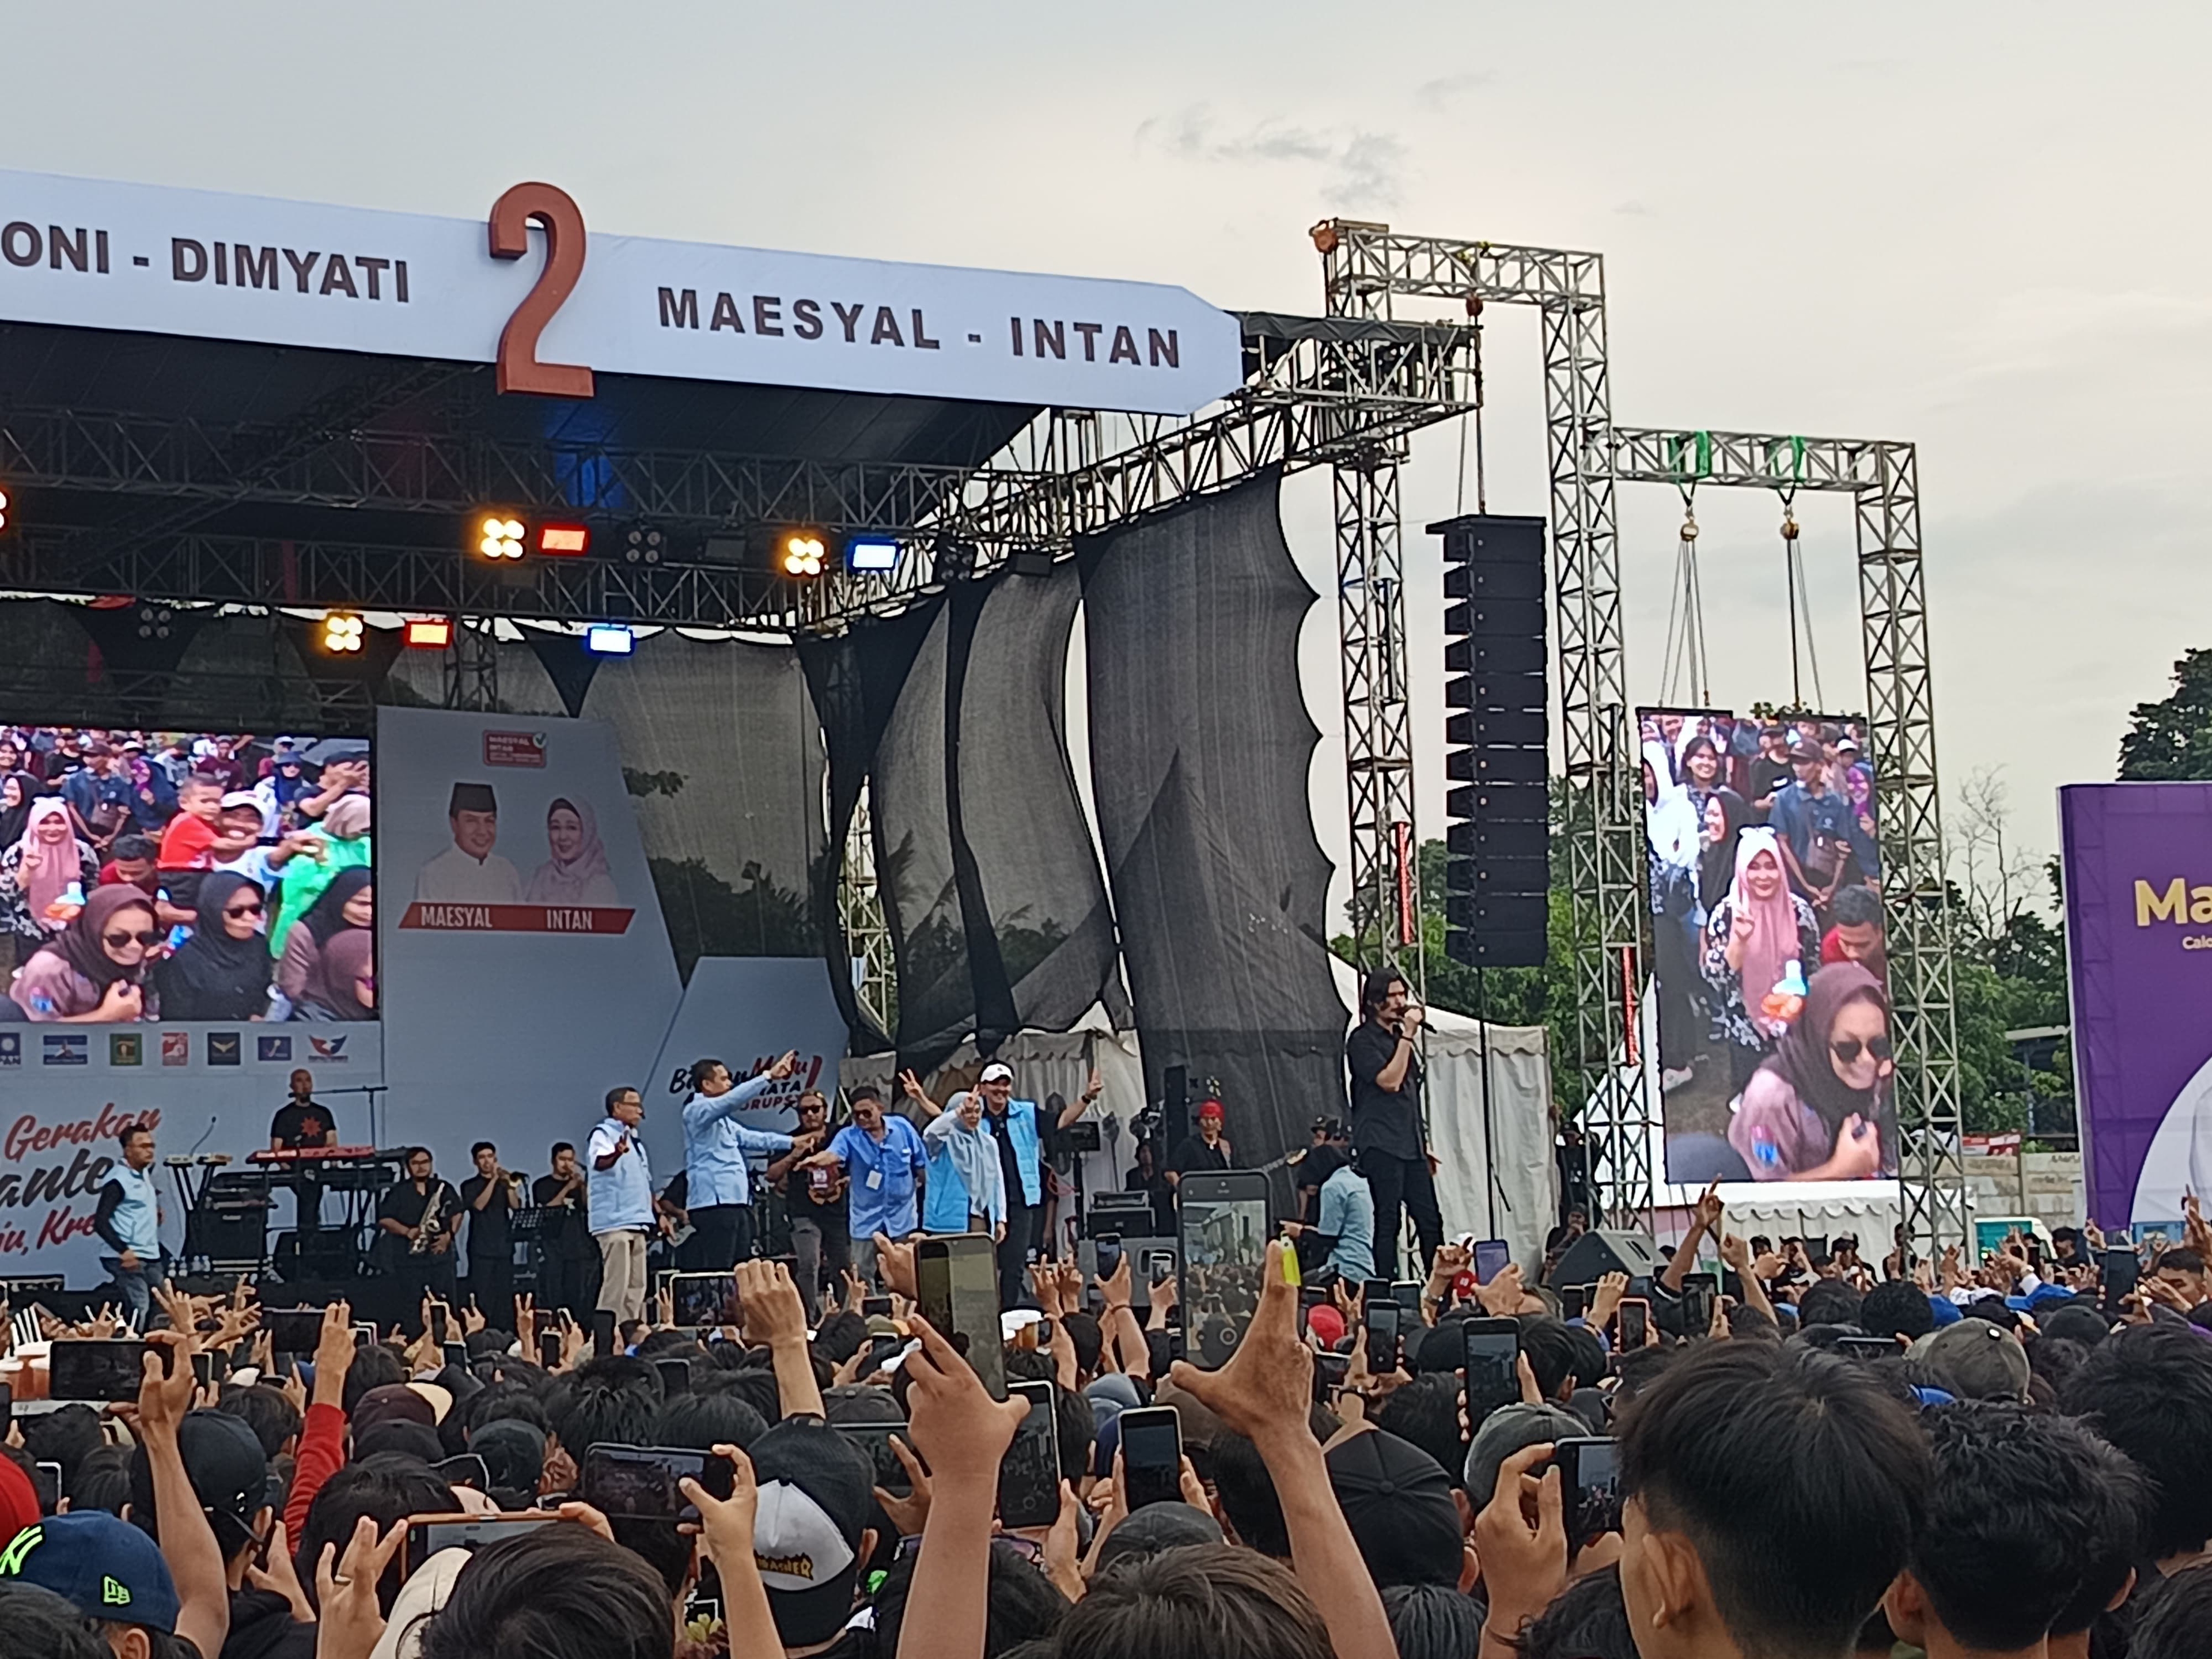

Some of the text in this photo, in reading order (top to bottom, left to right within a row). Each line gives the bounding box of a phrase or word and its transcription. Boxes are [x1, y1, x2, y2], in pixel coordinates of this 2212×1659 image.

[2, 221, 410, 304] ONI - DIMYATI
[488, 181, 594, 396] 2
[658, 286, 1179, 369] MAESYAL - INTAN
[421, 906, 593, 930] MAESYAL INTAN
